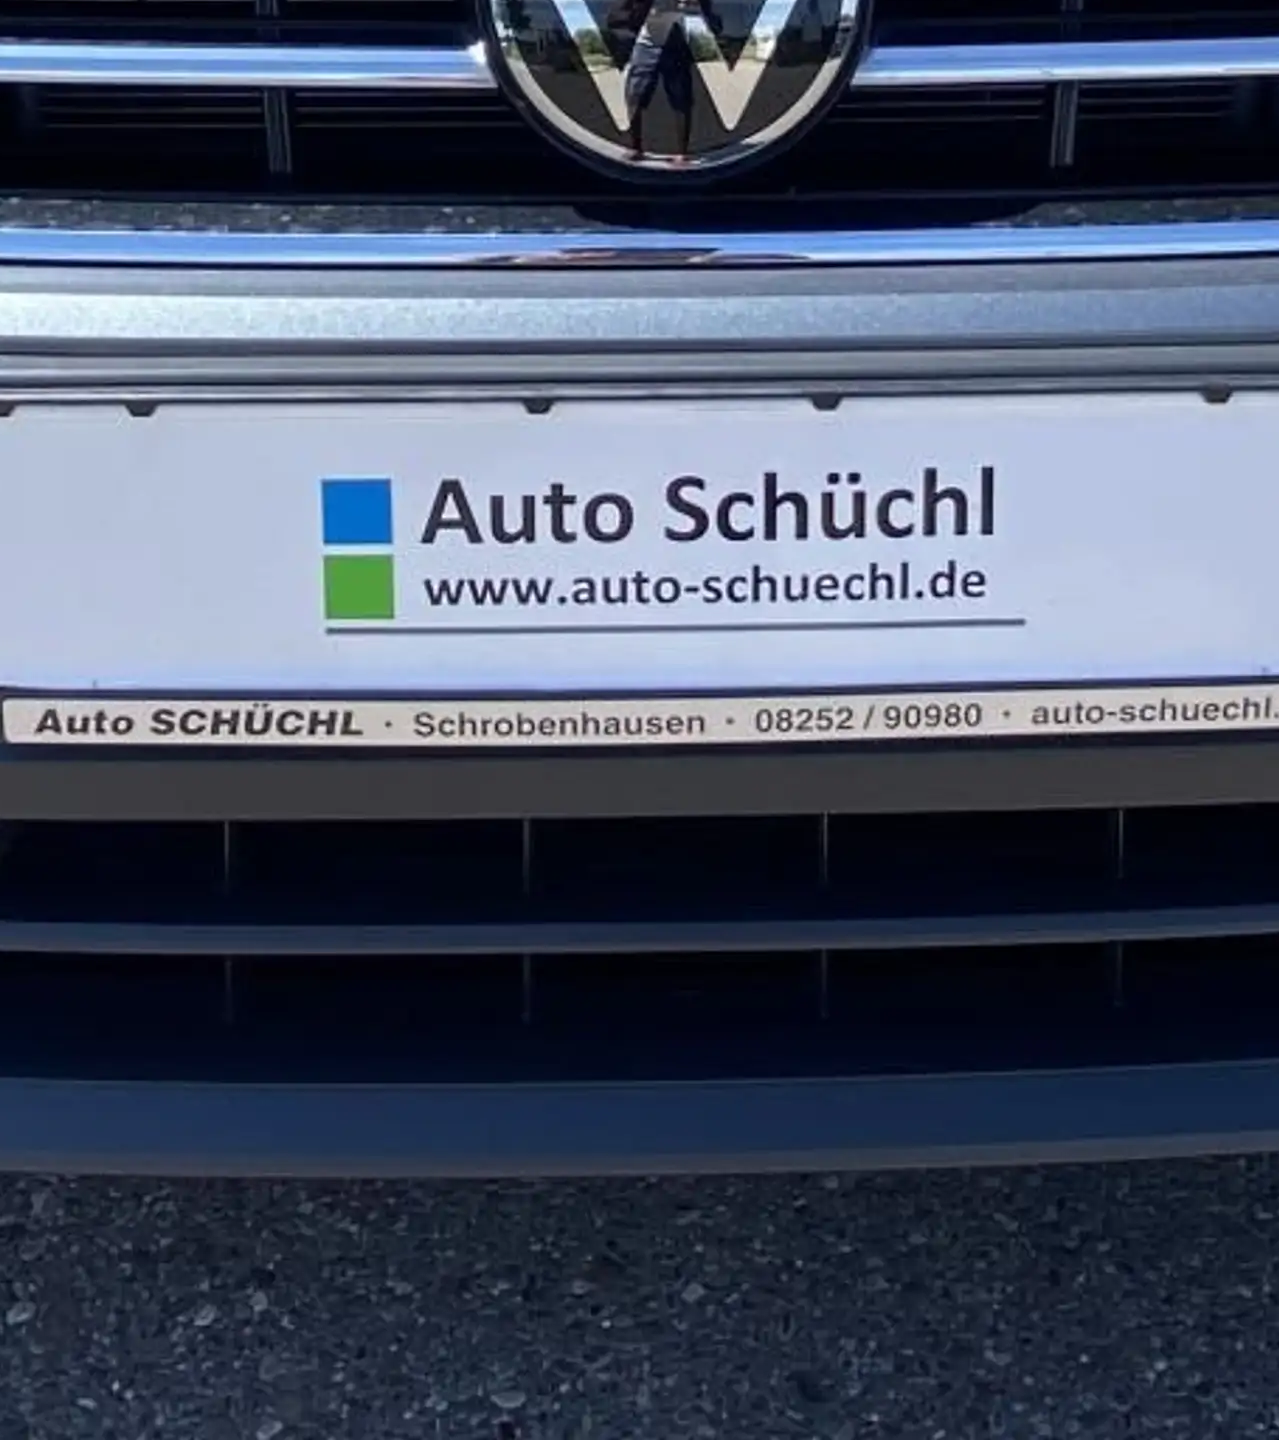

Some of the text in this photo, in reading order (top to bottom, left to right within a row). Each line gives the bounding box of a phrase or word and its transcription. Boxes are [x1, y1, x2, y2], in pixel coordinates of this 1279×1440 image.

[420, 466, 995, 545] Auto Schüchl
[423, 561, 986, 606] www.auto-schuechl.de
[35, 708, 134, 736] Auto
[150, 703, 364, 736] SCHÜCHL
[414, 712, 705, 738] Schrobenhausen
